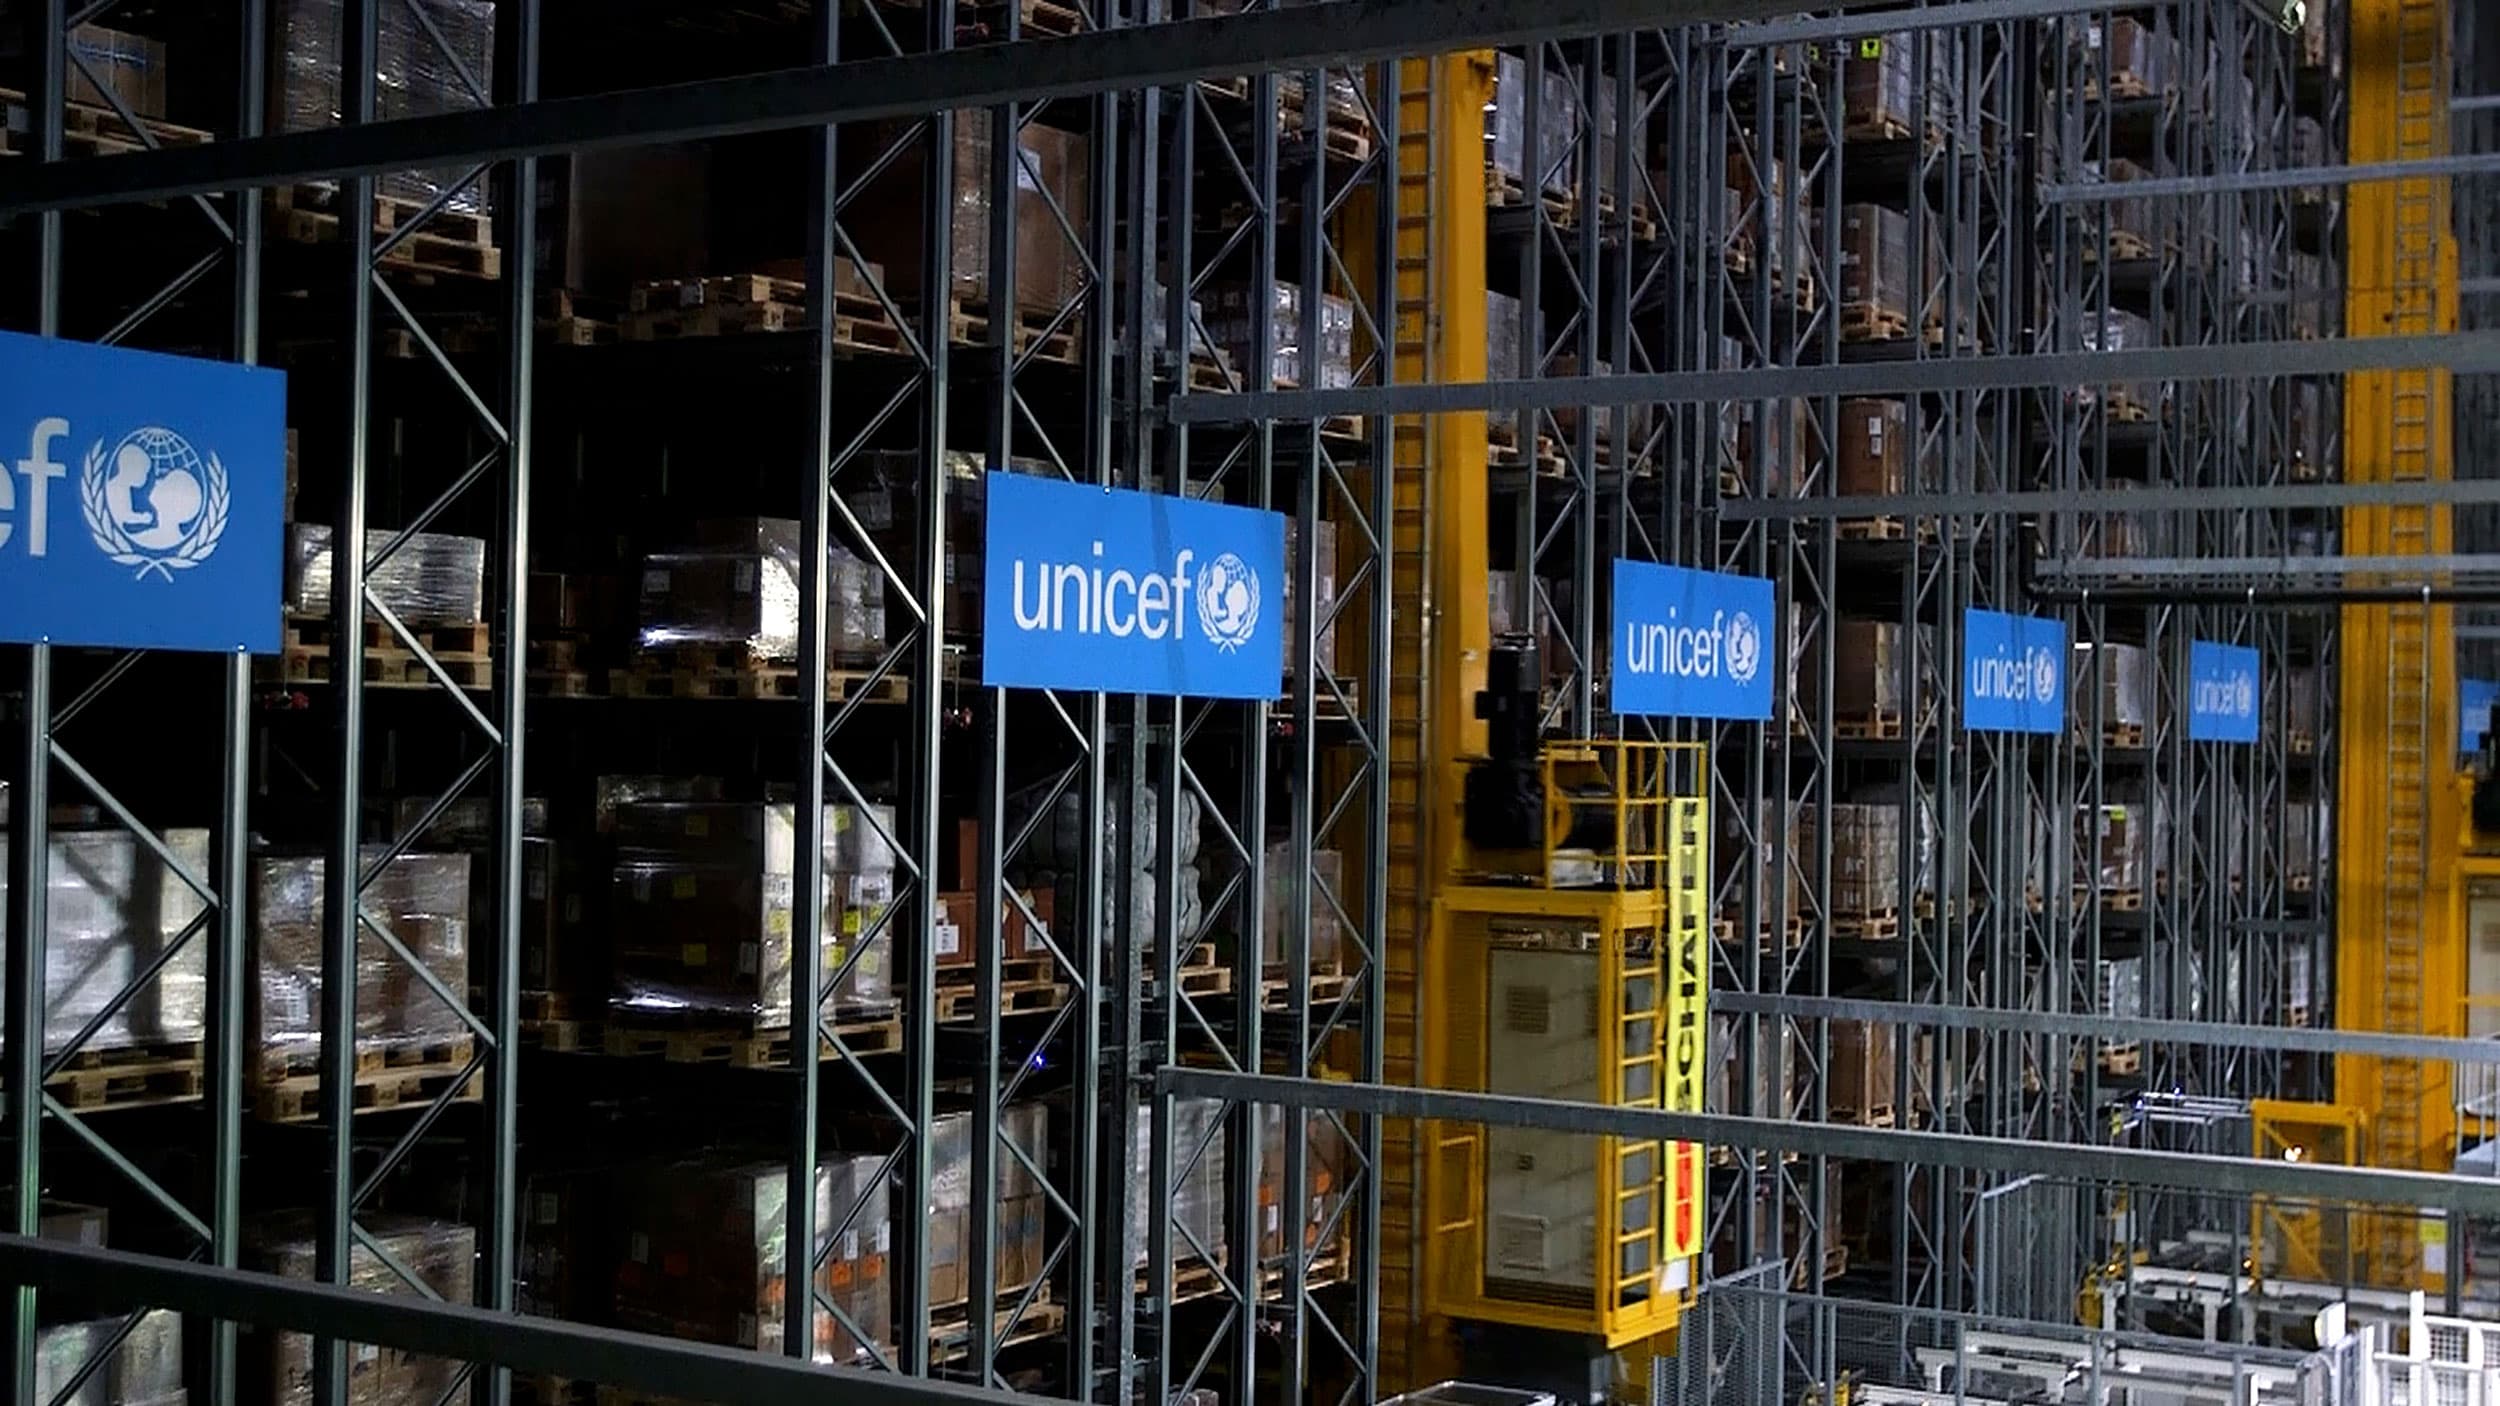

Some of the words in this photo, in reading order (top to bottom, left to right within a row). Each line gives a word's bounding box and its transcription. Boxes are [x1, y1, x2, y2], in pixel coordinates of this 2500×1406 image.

[1013, 540, 1193, 640] unicef
[1627, 605, 1724, 679] unicef
[1973, 643, 2034, 700] unicef
